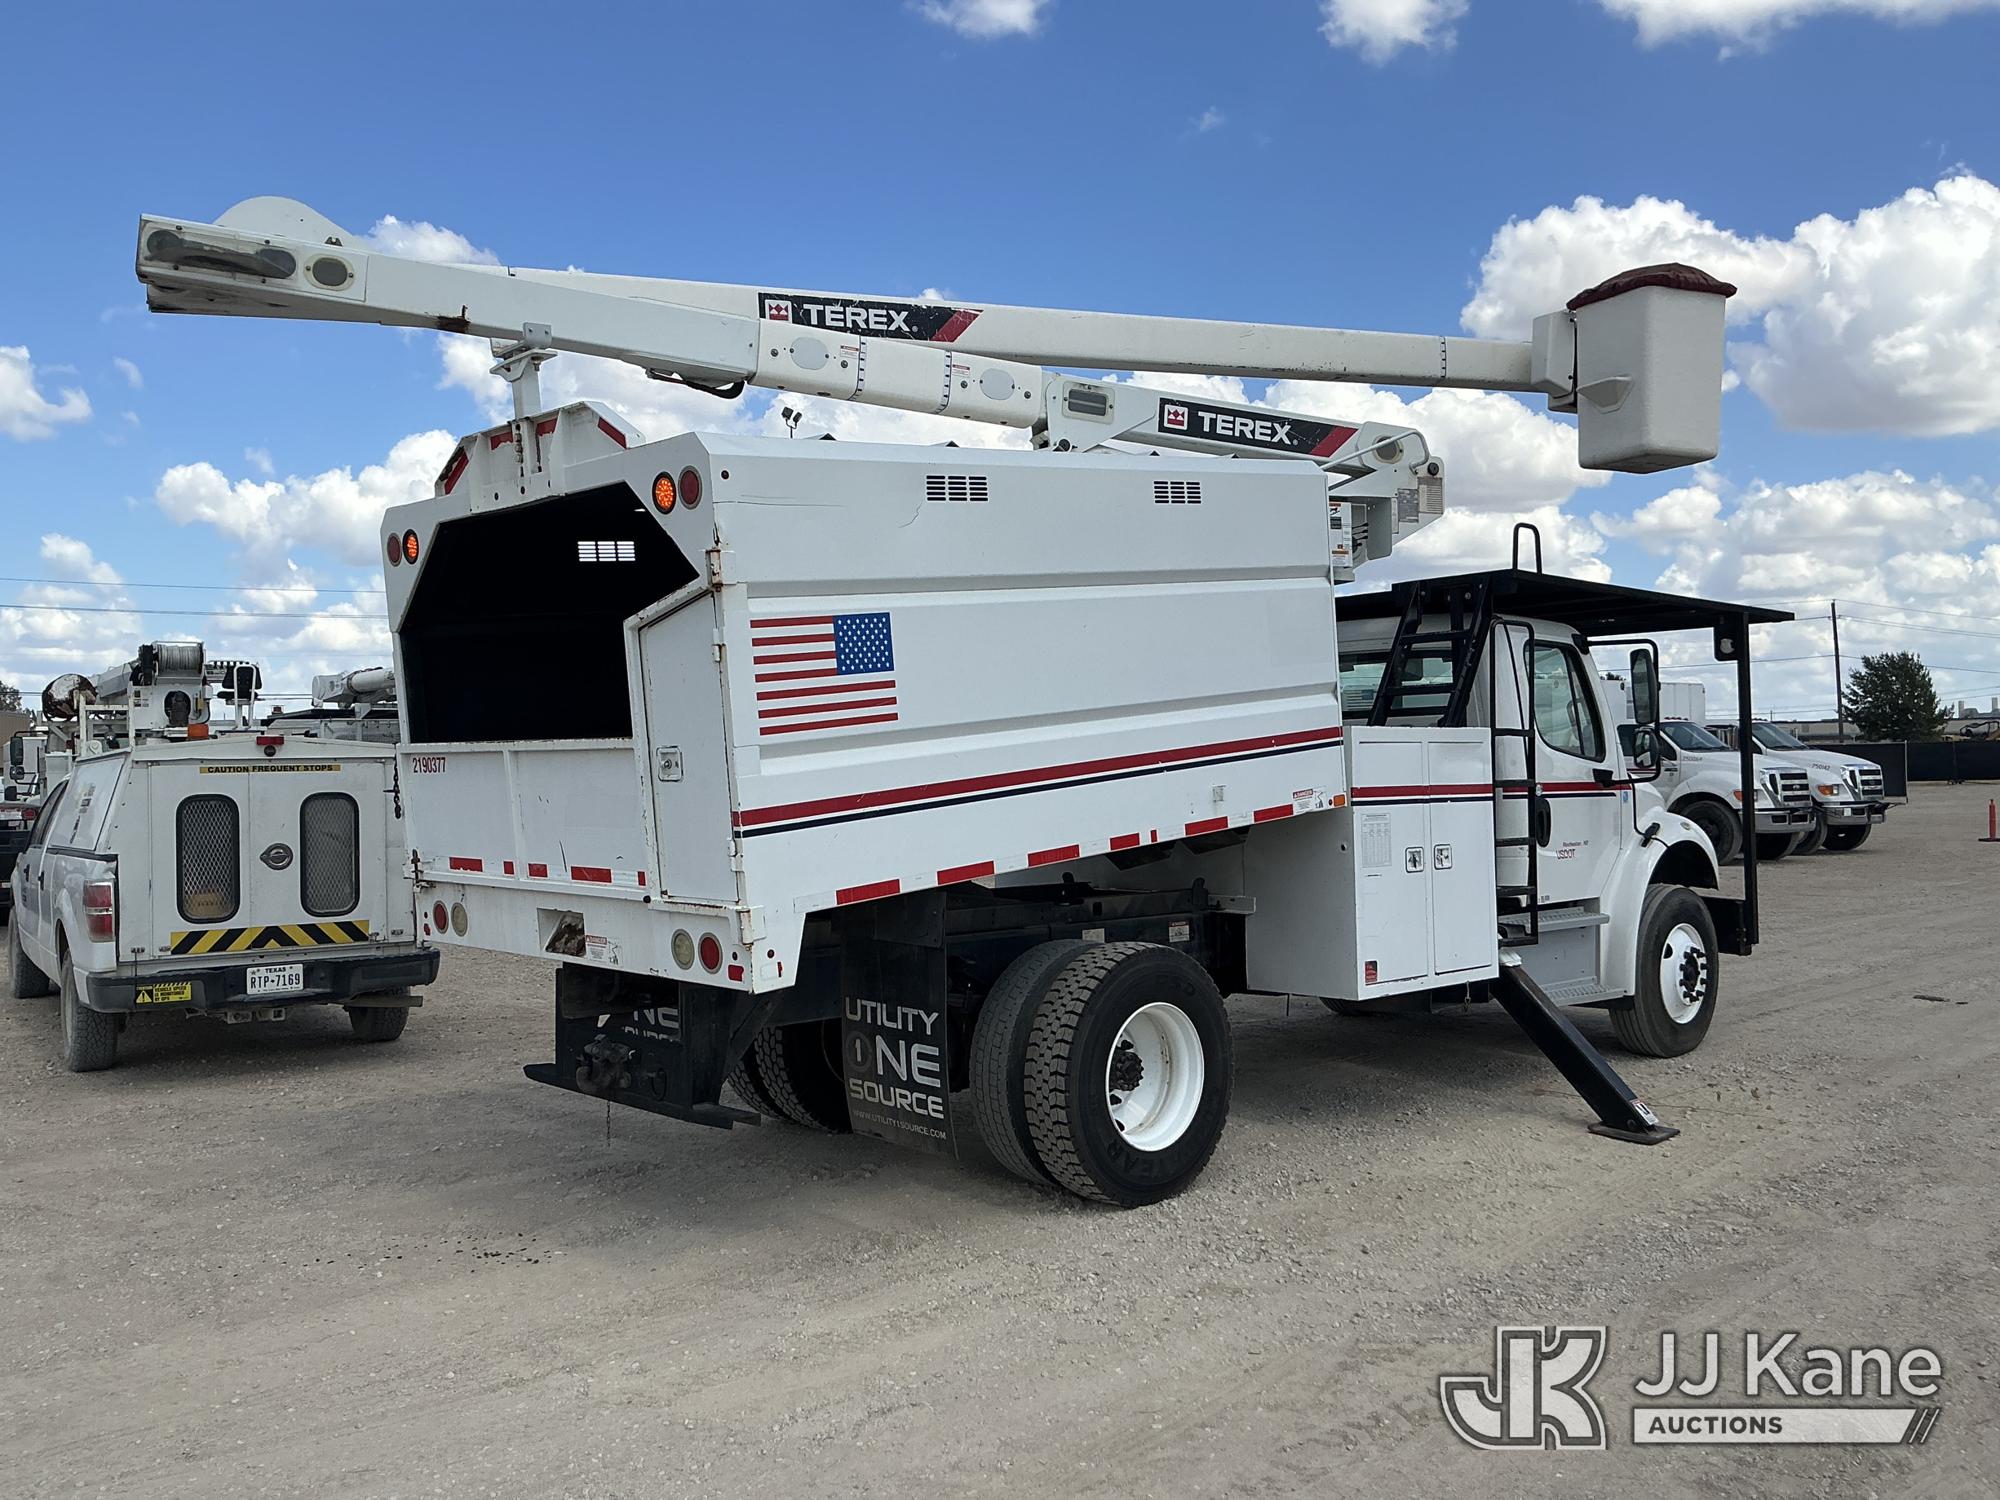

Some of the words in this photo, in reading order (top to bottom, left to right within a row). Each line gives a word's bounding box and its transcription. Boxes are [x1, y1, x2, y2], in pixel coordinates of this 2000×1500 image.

[803, 303, 910, 332] TEREX
[1198, 411, 1292, 445] TEREX
[207, 766, 249, 774] CAUTION
[251, 765, 300, 773] FREQUENT
[303, 764, 333, 772] STOPS
[412, 756, 446, 773] 2190377
[845, 996, 940, 1036] UTILITY
[849, 1077, 945, 1119] SOURCE
